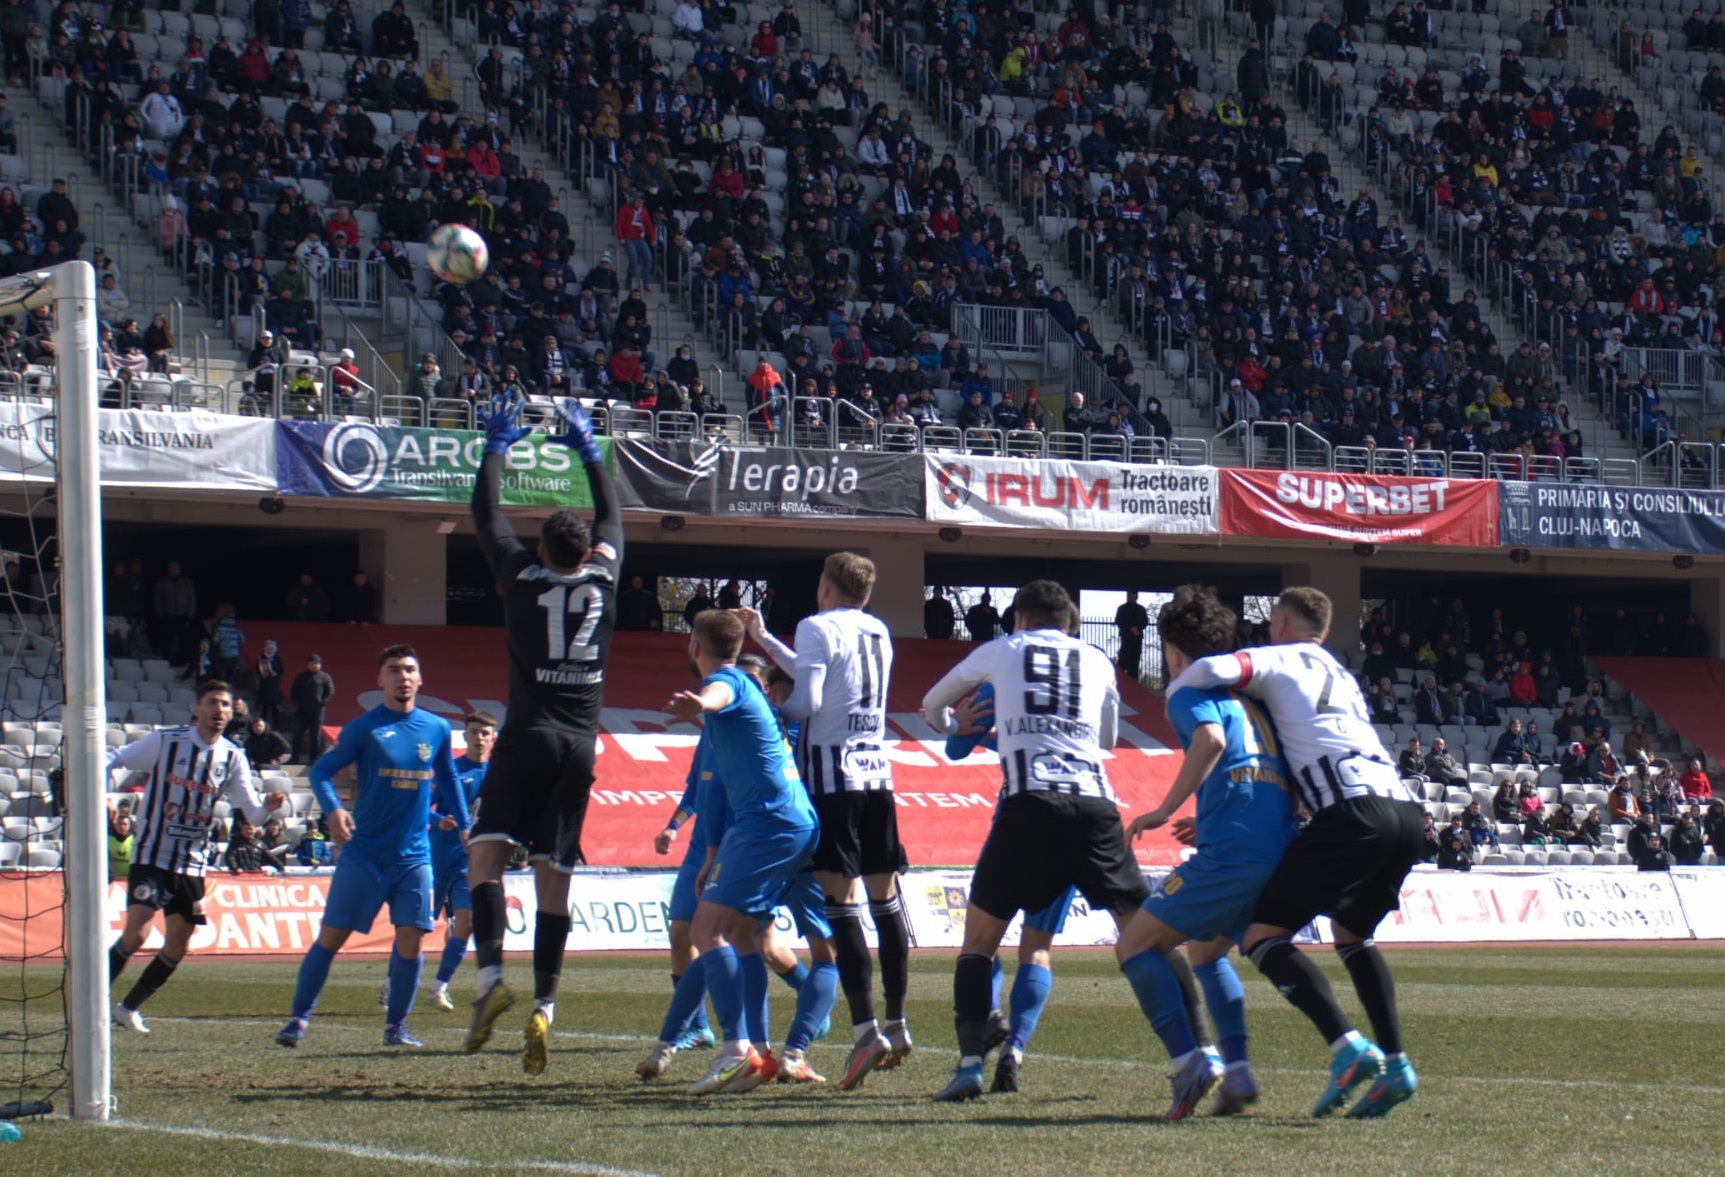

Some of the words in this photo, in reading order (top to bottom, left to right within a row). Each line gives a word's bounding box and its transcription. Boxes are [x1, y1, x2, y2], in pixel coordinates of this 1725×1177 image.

[98, 429, 214, 449] RANSILVANIA
[392, 469, 476, 487] Transilvan
[722, 447, 858, 501] Terapia
[1120, 469, 1209, 492] Tractoare
[985, 471, 1110, 511] IRUM
[1276, 473, 1449, 515] SUPERBET
[728, 503, 736, 512] a
[737, 501, 763, 512] SUN
[764, 501, 812, 514] PHARMA
[1539, 516, 1642, 538] CLUJ-NAPOCA
[537, 584, 603, 660] 12
[857, 633, 883, 708] 11
[1024, 645, 1081, 718] 91
[213, 884, 327, 908] CLINICA
